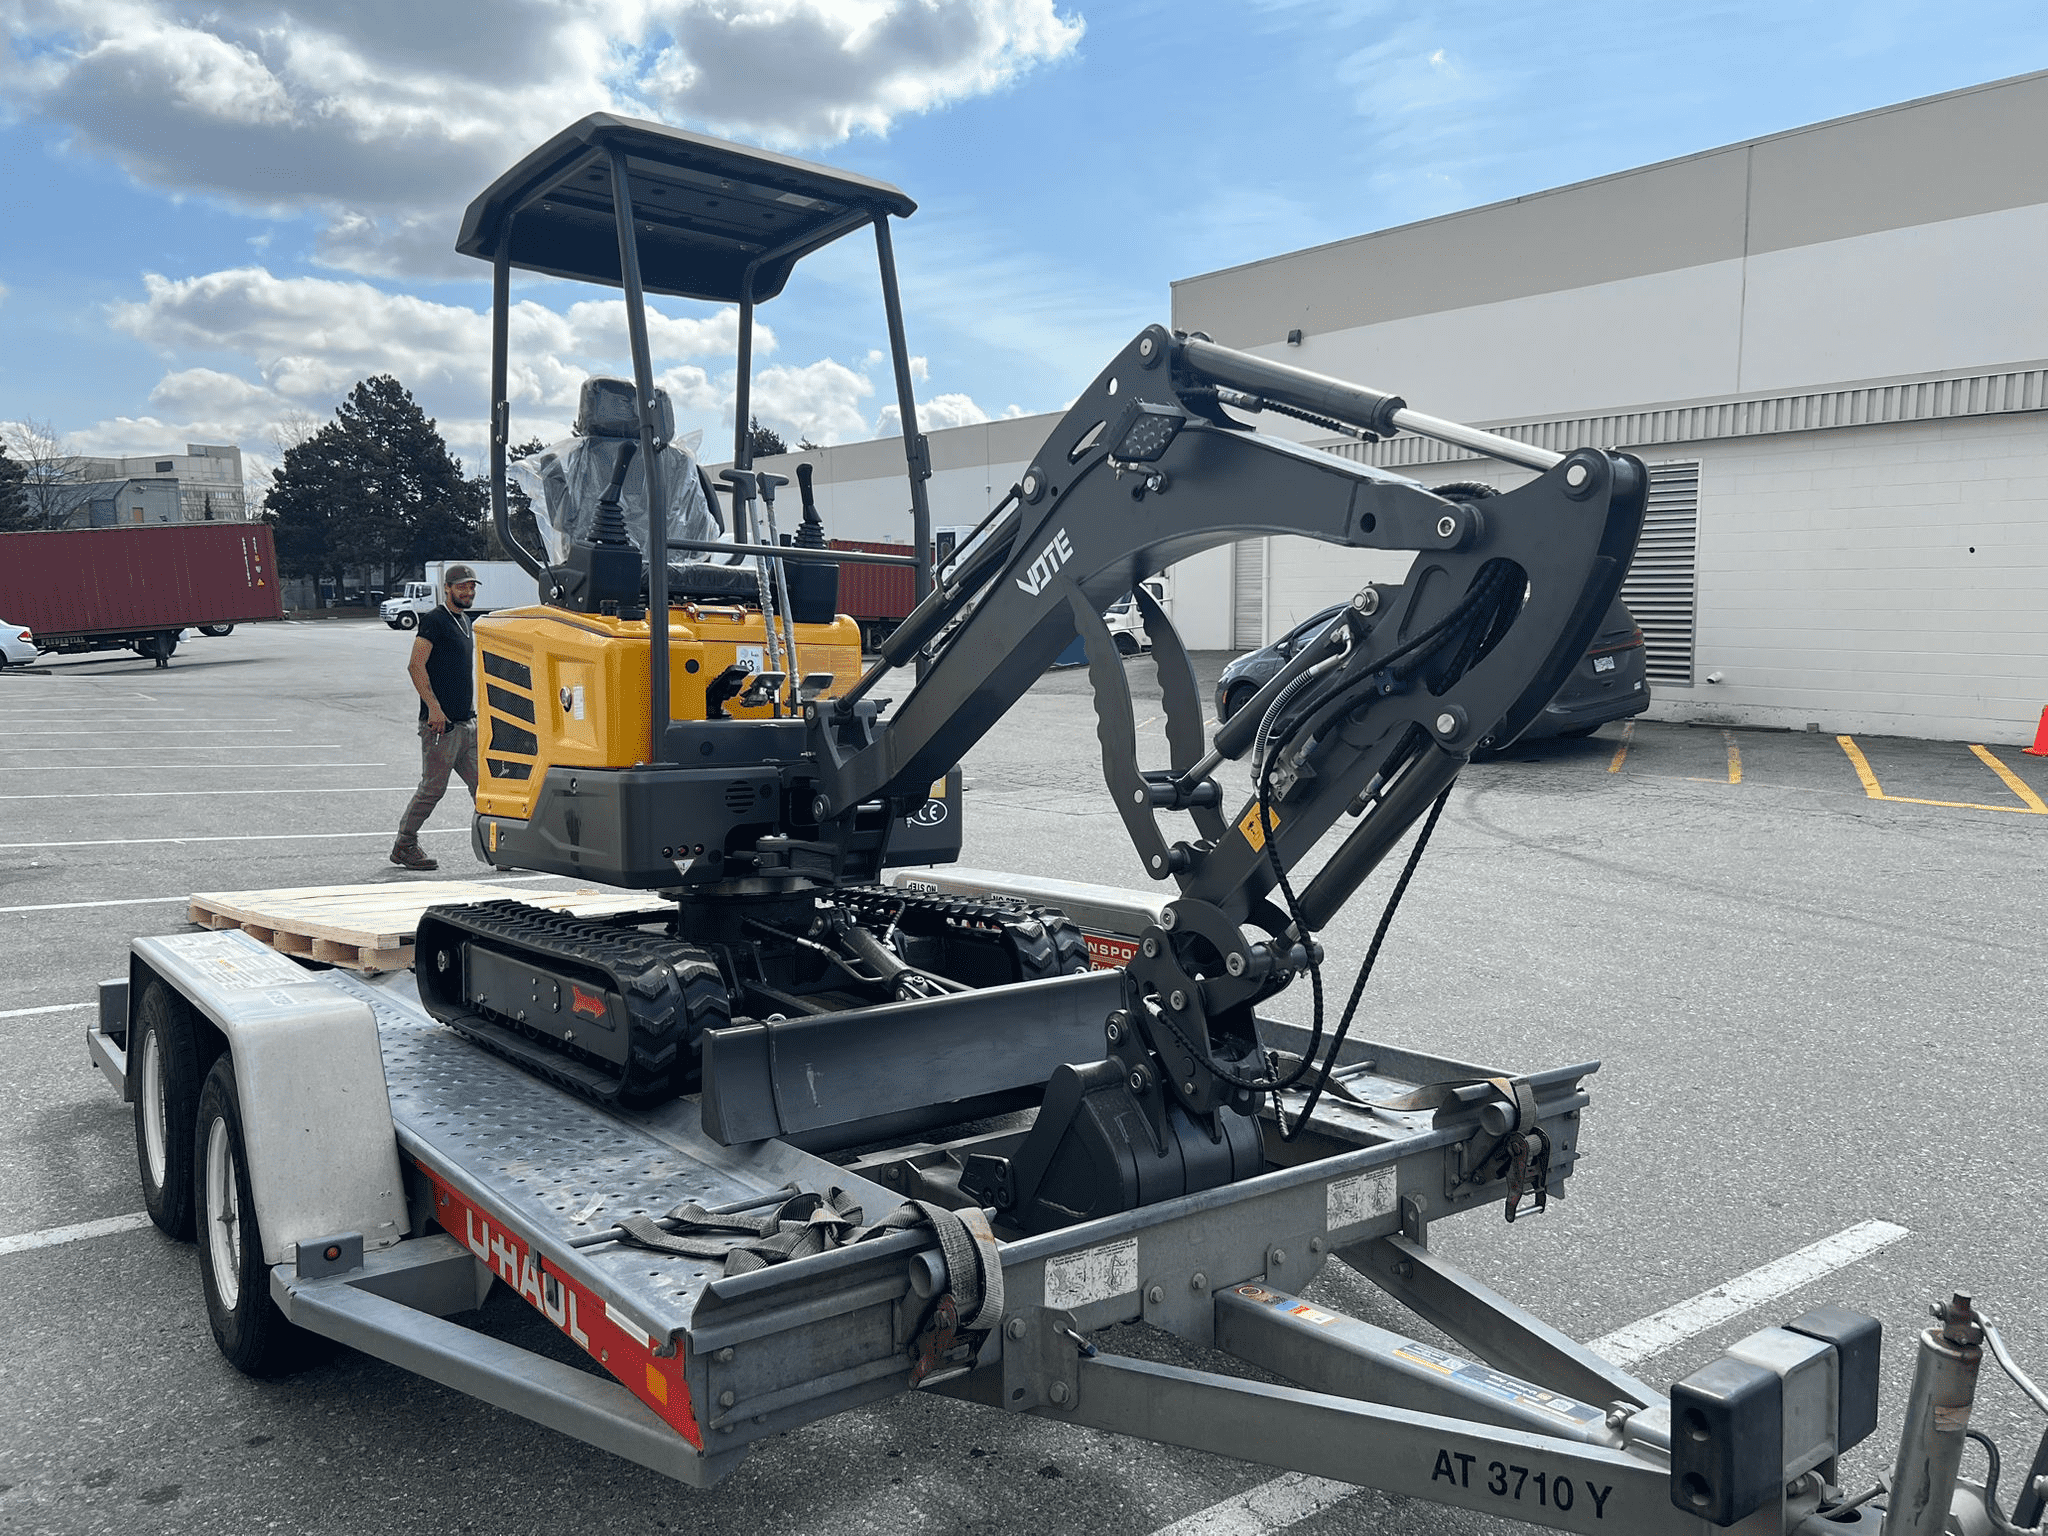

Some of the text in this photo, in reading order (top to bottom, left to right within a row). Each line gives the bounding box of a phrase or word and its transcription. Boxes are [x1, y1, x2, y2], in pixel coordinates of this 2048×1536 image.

[1015, 527, 1075, 597] VOTE
[466, 1207, 589, 1350] U-HAUL
[1431, 1449, 1613, 1519] AT 3710 Y
